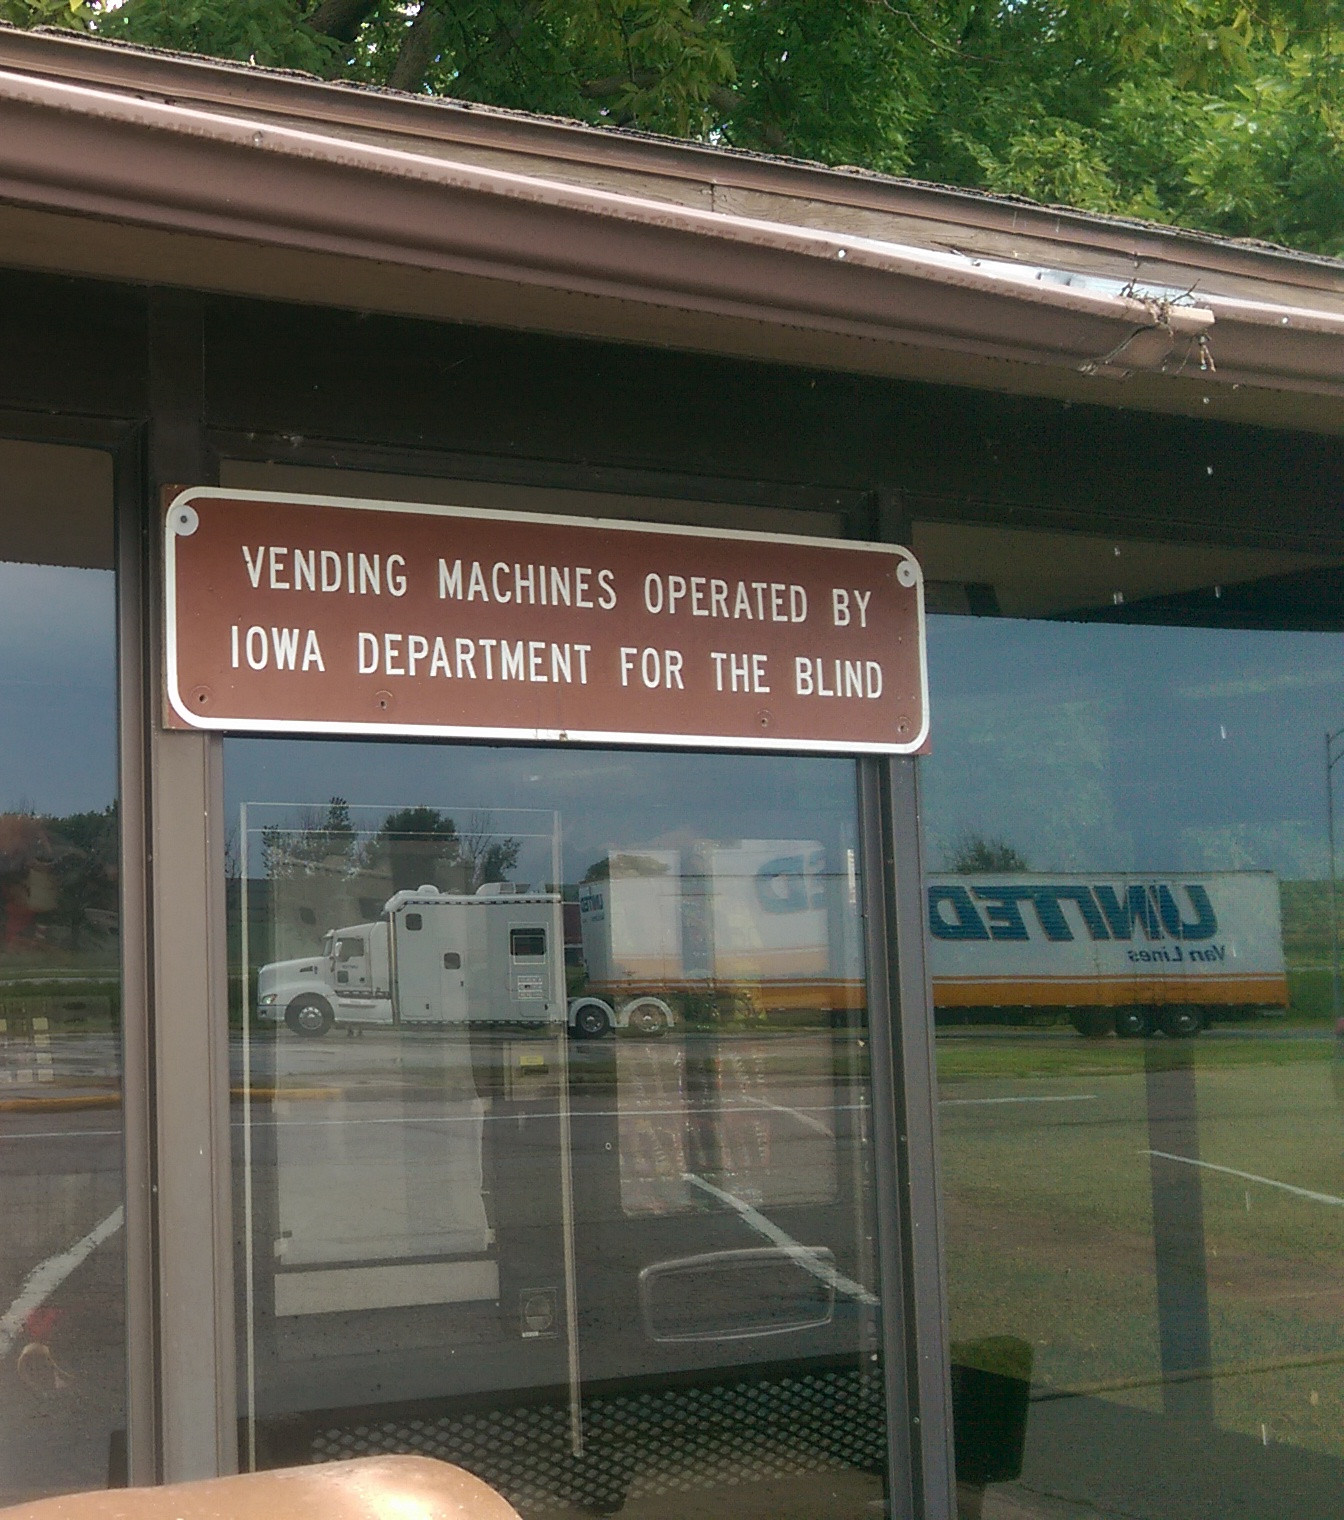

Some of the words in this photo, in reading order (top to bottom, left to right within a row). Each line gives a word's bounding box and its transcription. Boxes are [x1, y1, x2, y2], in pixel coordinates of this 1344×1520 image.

[242, 545, 408, 597] VENDING
[439, 558, 617, 610] MACHINES
[644, 573, 807, 623] OPERATED
[832, 588, 871, 628] BY
[231, 625, 325, 672] IOWA
[358, 632, 592, 685] DEPARTMENT
[620, 647, 684, 689] FOR
[710, 652, 770, 693] THE
[795, 657, 883, 699] BLIND
